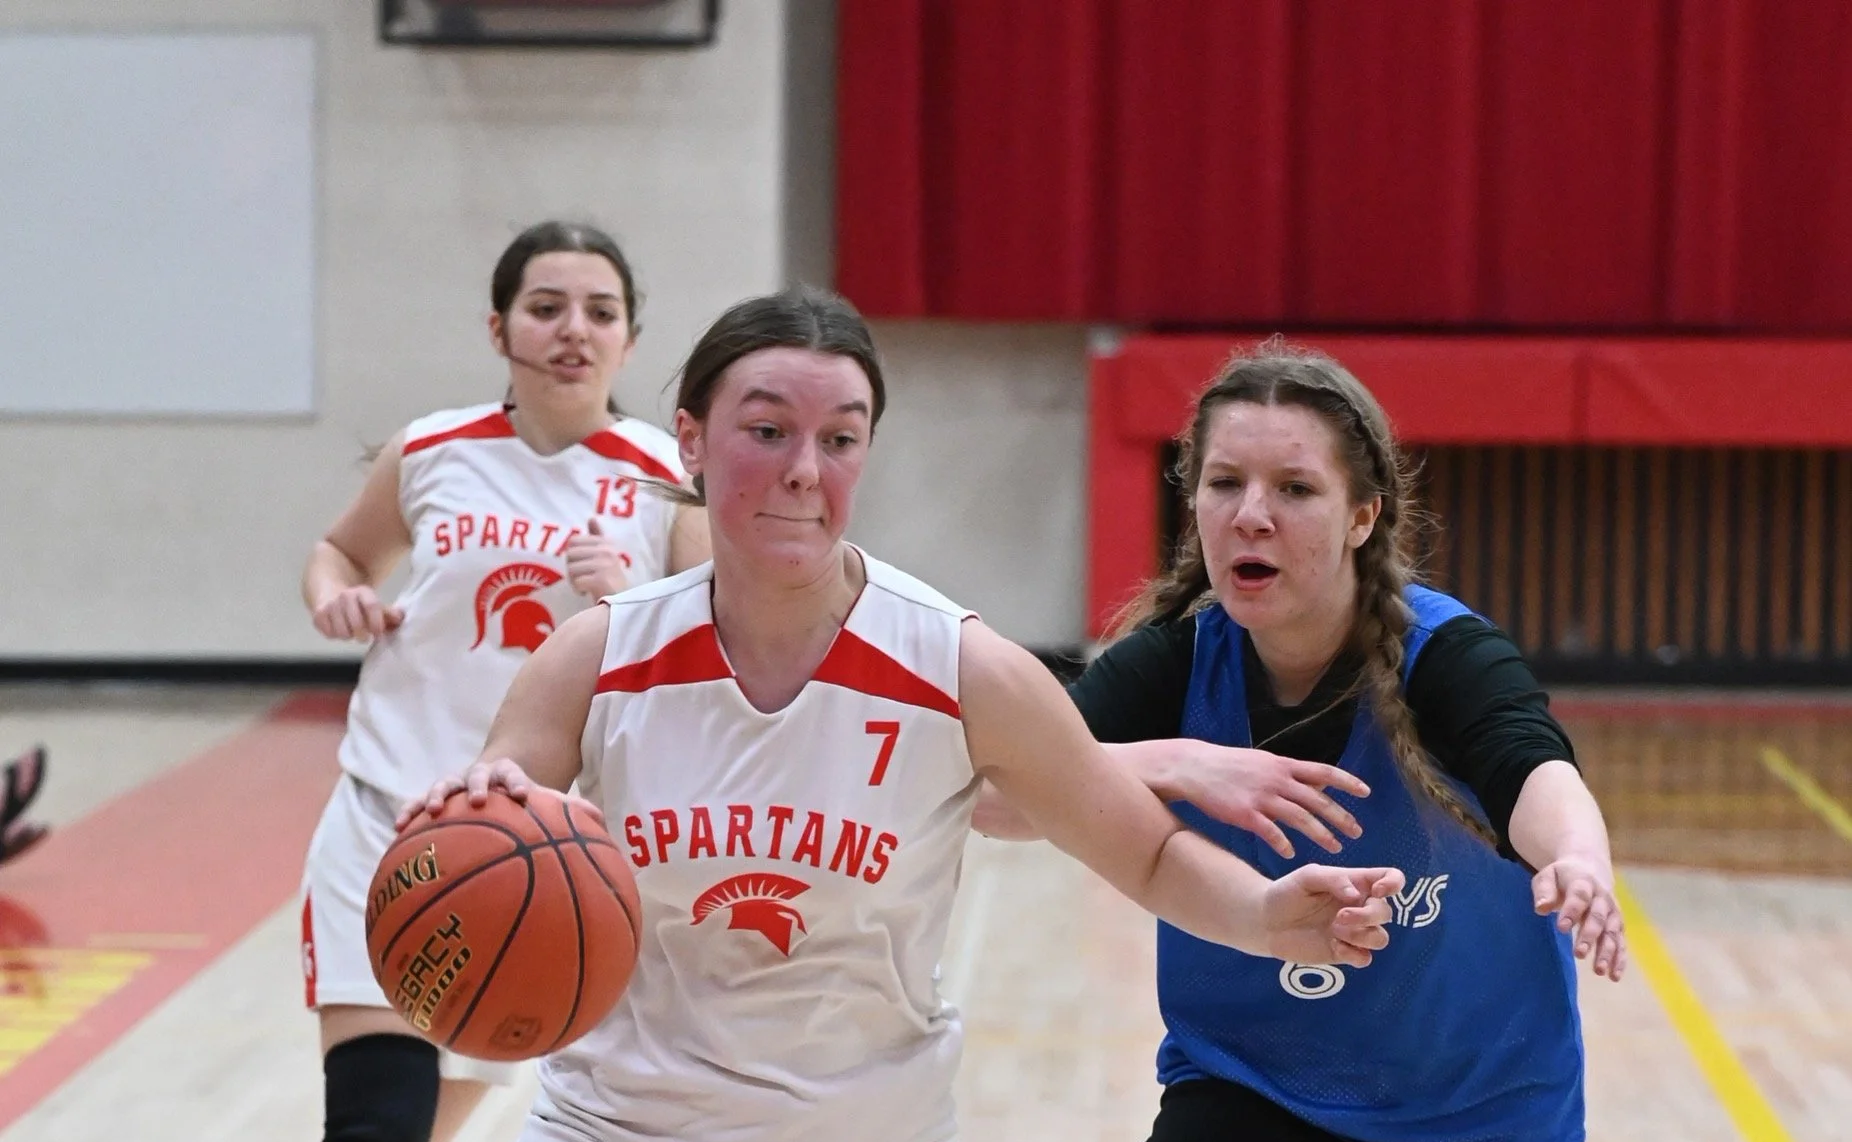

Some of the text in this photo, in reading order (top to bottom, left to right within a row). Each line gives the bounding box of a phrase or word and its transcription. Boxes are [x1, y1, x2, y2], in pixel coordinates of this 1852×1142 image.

[595, 478, 636, 518] 13
[434, 513, 632, 569] SPART
[865, 721, 900, 786] 7
[624, 804, 898, 884] SPARTANS
[367, 842, 440, 932] DING
[1391, 874, 1449, 928] YS
[393, 911, 462, 1018] EGACY
